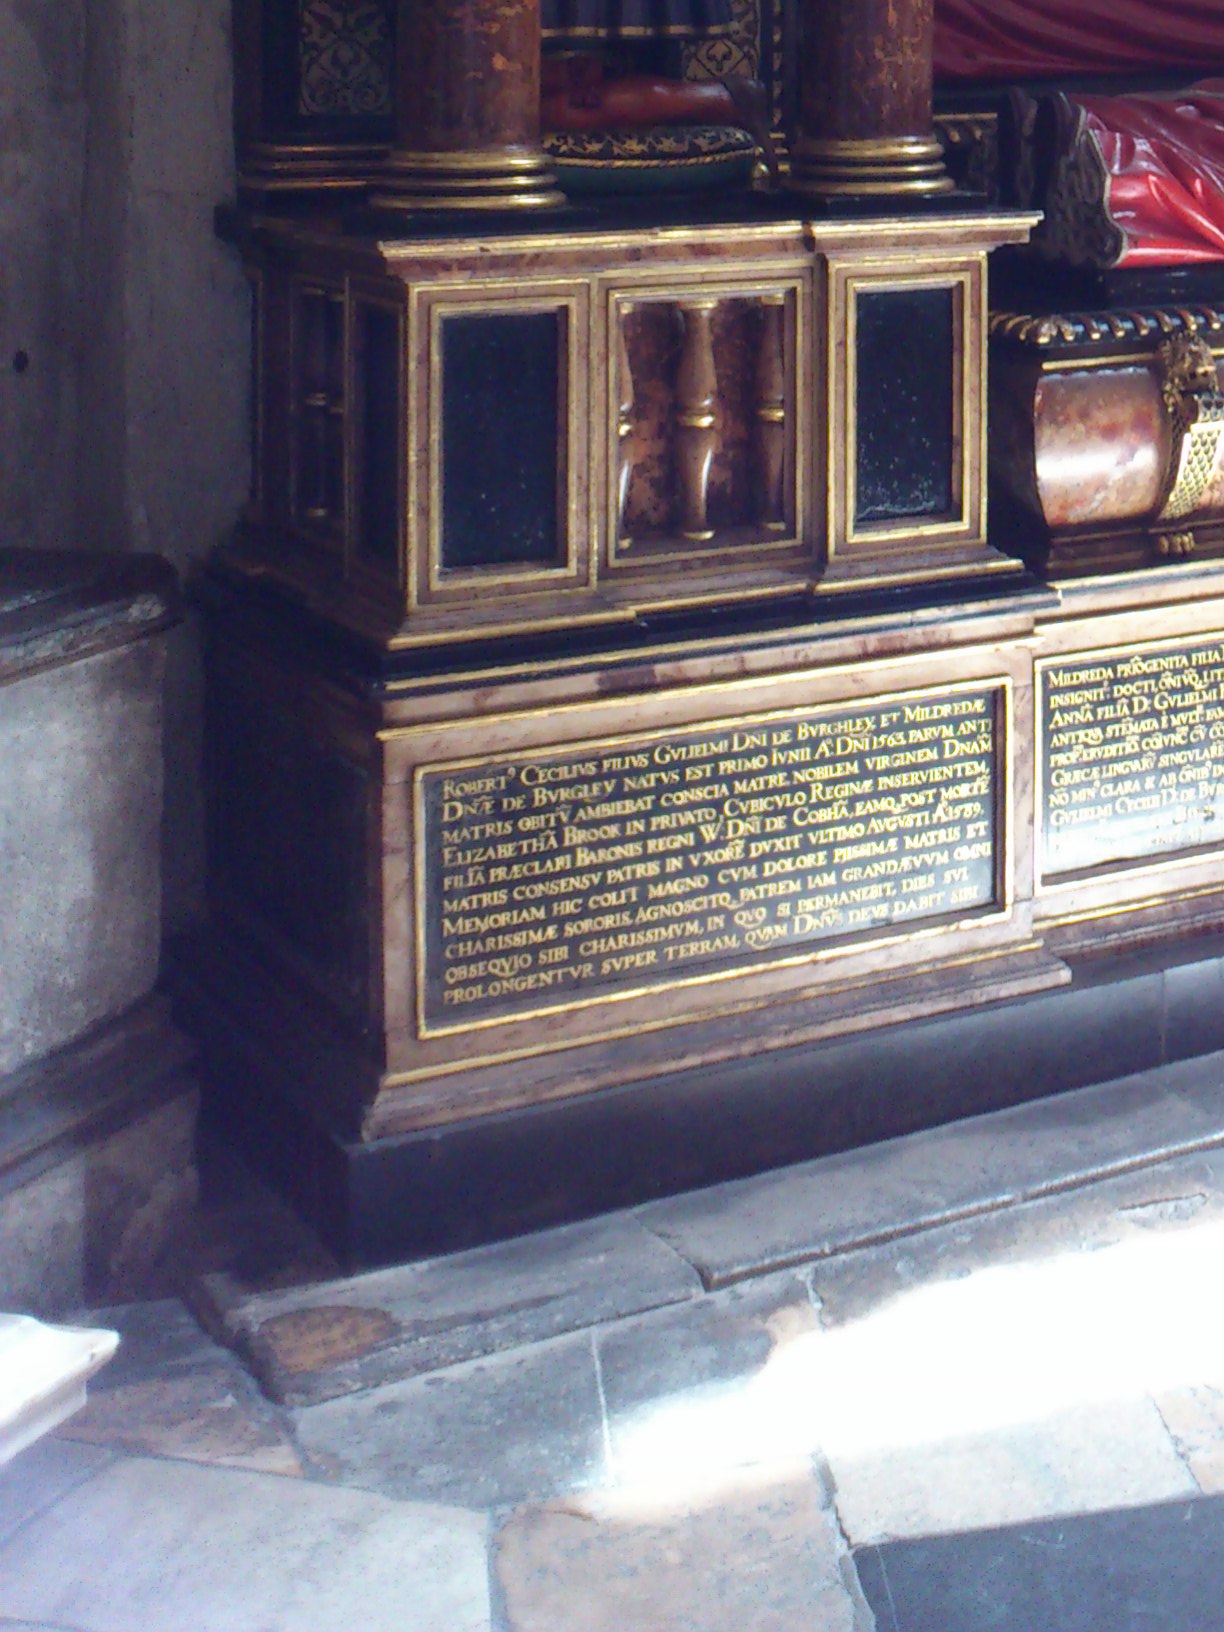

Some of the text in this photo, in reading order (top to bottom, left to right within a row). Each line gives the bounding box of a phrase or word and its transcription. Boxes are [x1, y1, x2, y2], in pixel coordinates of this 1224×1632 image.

[1048, 667, 1113, 687] MILDREDA
[1191, 650, 1220, 665] FILIA
[1153, 684, 1217, 709] GVLIELMI
[502, 794, 525, 810] DE
[623, 769, 679, 791] NATVS
[685, 763, 714, 780] EST
[718, 754, 768, 774] PRIMO
[772, 747, 810, 765] IVNII
[908, 724, 954, 743] PARVM
[520, 761, 596, 785] CECILIVS
[602, 754, 648, 772] FILIVS
[654, 739, 728, 764] GVLIELMI
[772, 729, 791, 745] DE
[880, 712, 900, 727] ET
[903, 698, 985, 722] MILDREDÆ
[442, 820, 512, 843] MATRIS
[574, 795, 655, 821] AMBIEBAT
[660, 783, 729, 806] CONSCIA
[793, 760, 859, 784] NOBILEM
[864, 746, 938, 770] VIRGINEM
[563, 823, 620, 846] BROOK
[626, 819, 644, 834] IN
[723, 791, 806, 816] CVBICVLO
[576, 842, 642, 866] BARONIS
[647, 832, 694, 853] REGNI
[765, 815, 786, 831] DE
[899, 788, 936, 807] POST
[1099, 779, 1140, 797] CLARA
[442, 905, 545, 936] MEMORIAM
[552, 898, 582, 915] HIC
[588, 886, 636, 908] COLIT
[648, 874, 708, 898] MAGNO
[717, 864, 756, 883] CVM
[762, 850, 826, 876] DOLORE
[903, 826, 960, 849] MATRIS
[966, 820, 989, 838] ET
[443, 889, 507, 911] MATRIS
[512, 871, 601, 900] CONSENSV
[606, 861, 659, 883] PATRIS
[665, 856, 682, 872] IN
[749, 833, 802, 857] DVXIT
[807, 822, 864, 844] VLTIMO
[866, 810, 929, 834] AVGVSTI
[739, 879, 801, 901] PATREM
[807, 871, 836, 889] IAM
[953, 840, 991, 859] OMNI
[443, 962, 594, 1003] PROLONGENTVR
[601, 949, 657, 974] SVPER
[848, 902, 887, 925] DEVS
[892, 891, 944, 916] DABIT
[951, 884, 978, 904] SIBI
[444, 953, 532, 984] OBSEQVIO
[538, 945, 568, 963] SIBI
[707, 914, 724, 930] IN
[733, 906, 766, 928] QVO
[776, 902, 790, 916] SI
[901, 873, 934, 893] DIES
[943, 866, 968, 884] SVI
